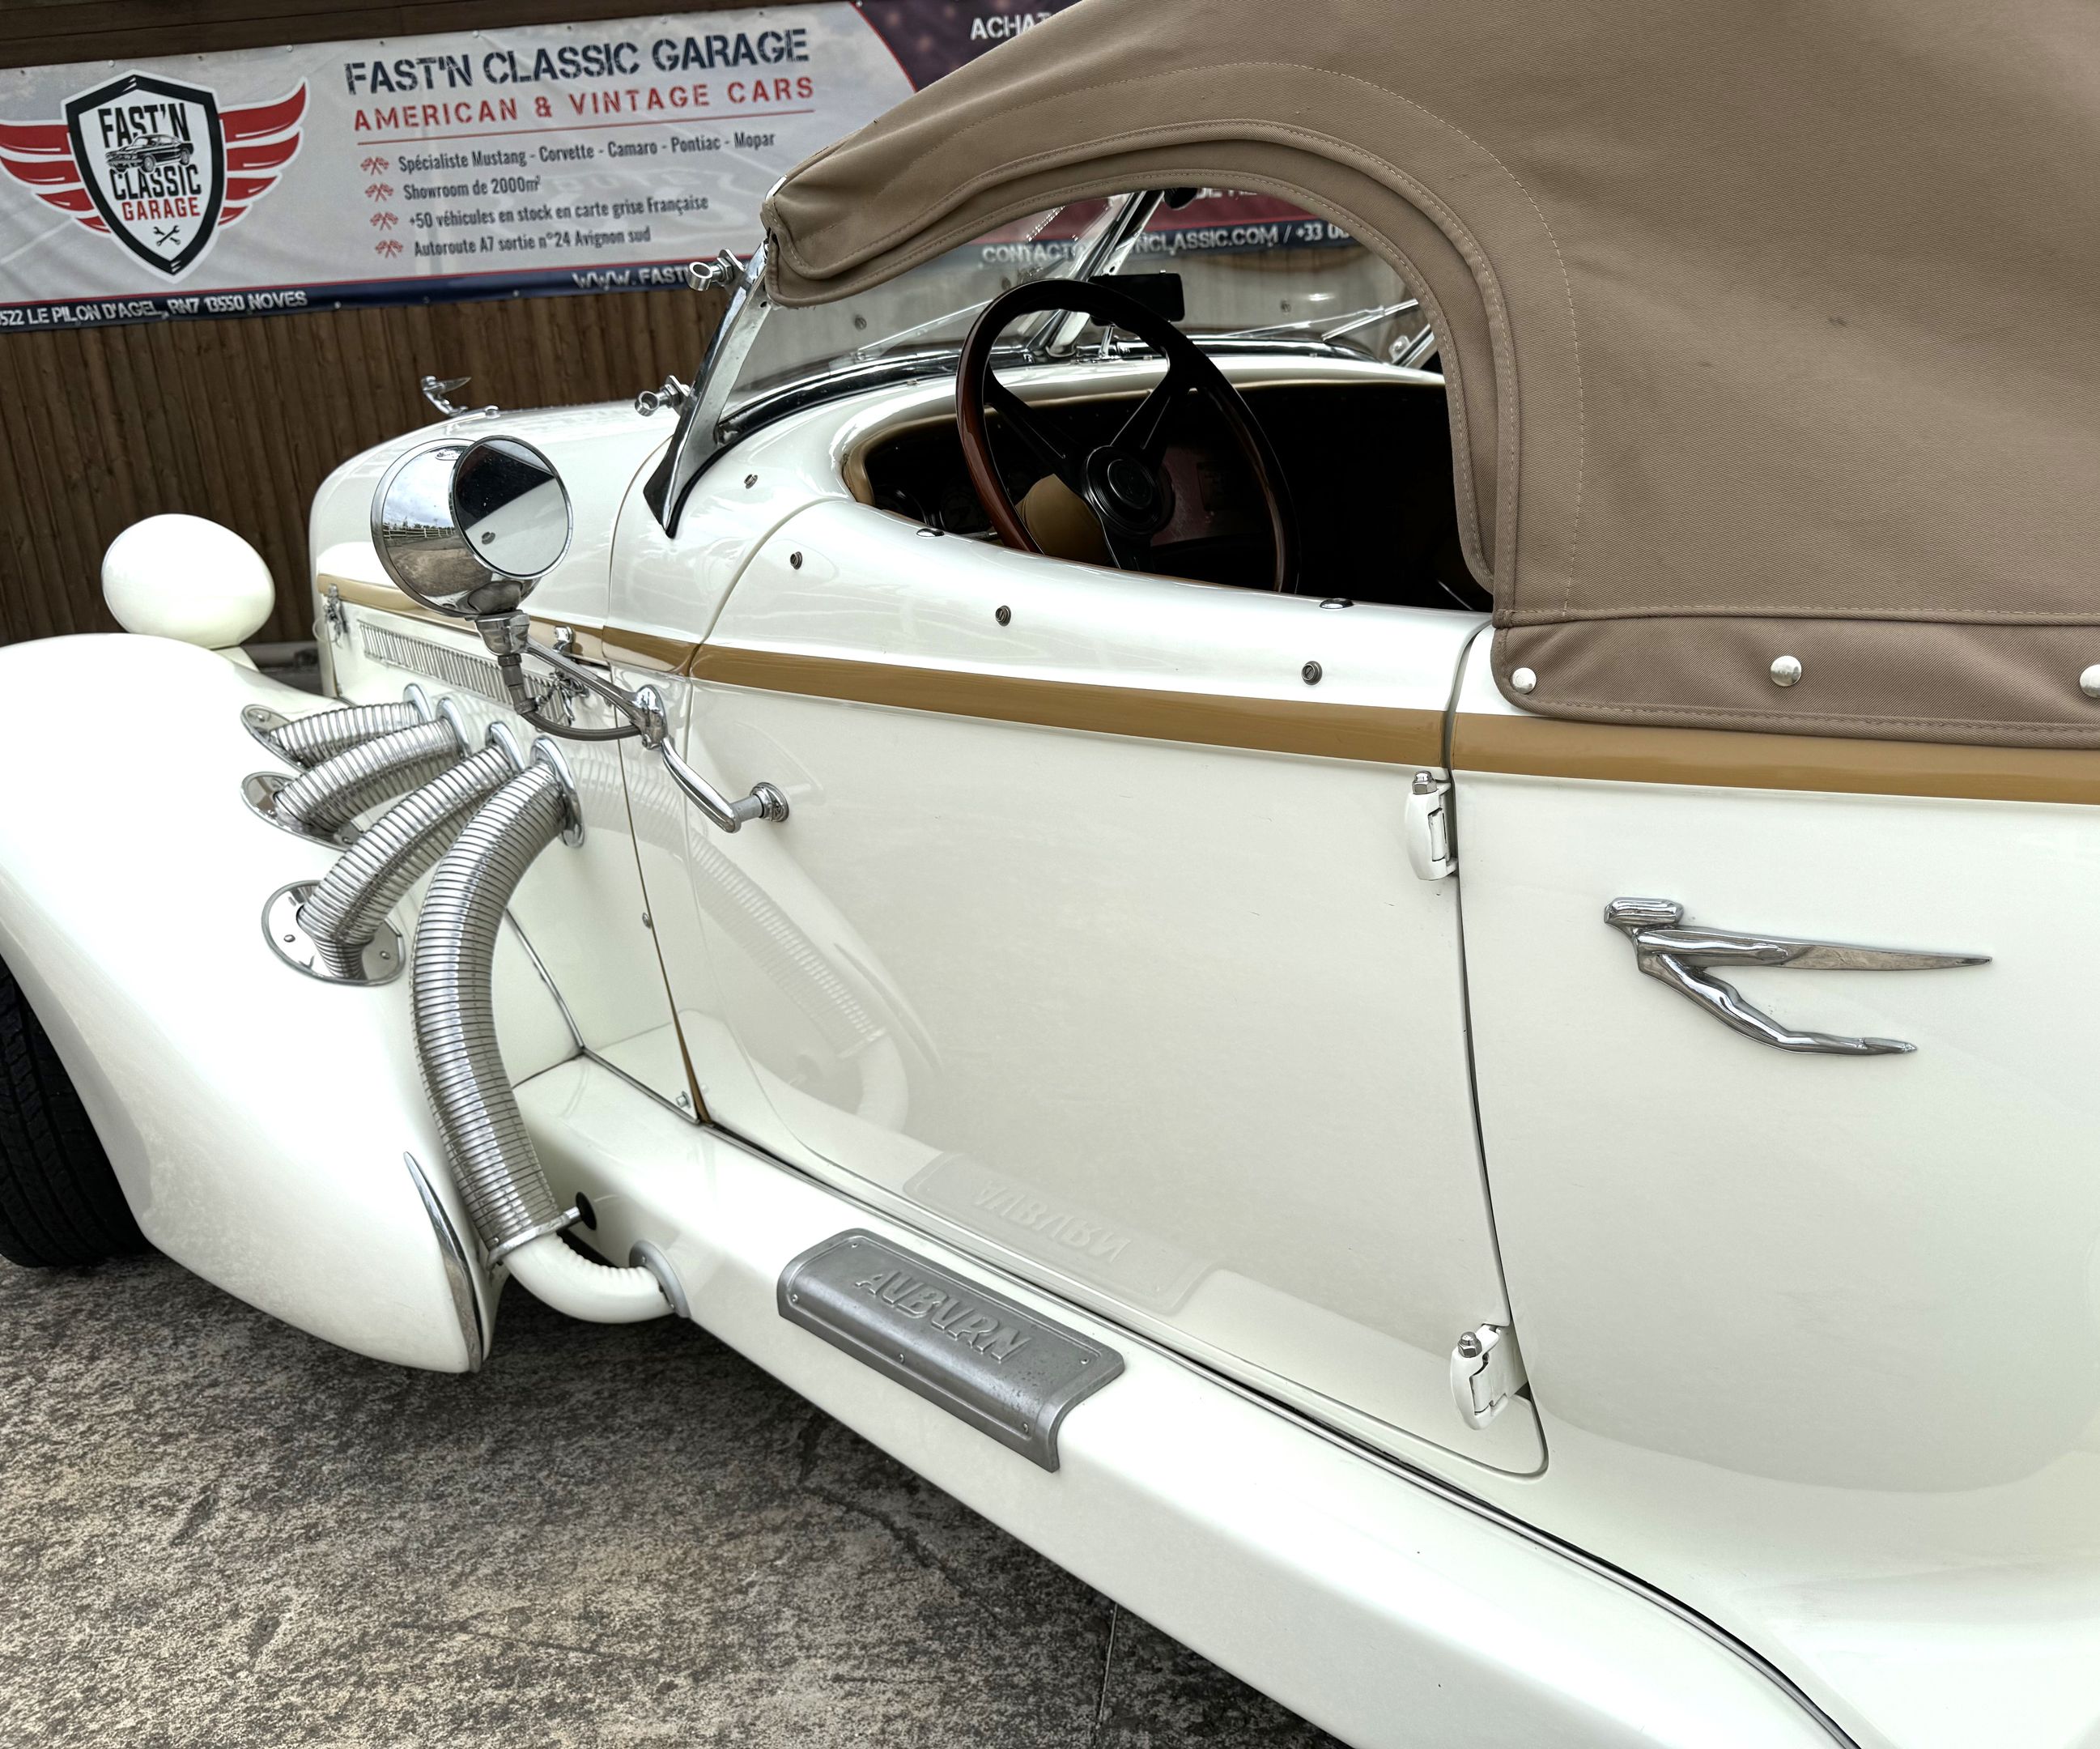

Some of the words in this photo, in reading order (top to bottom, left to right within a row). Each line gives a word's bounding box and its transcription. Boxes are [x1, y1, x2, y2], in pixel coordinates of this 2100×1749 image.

[344, 53, 474, 96] FAST'N
[483, 42, 640, 84] CLASSIC
[651, 28, 810, 72] GARAGE
[354, 96, 518, 132] AMERICAN
[534, 95, 553, 118] &
[568, 83, 710, 116] VINTAGE
[727, 76, 814, 104] CARS
[98, 103, 191, 148] FAST'N
[398, 152, 470, 175] Spécialiste
[470, 149, 528, 168] Mustang
[538, 143, 595, 163] Corvette
[608, 140, 658, 158] Camaro
[670, 134, 722, 153] Pontiac
[733, 130, 777, 149] Mopar
[109, 164, 202, 201] CLASSIC
[403, 184, 470, 201] Showroom
[472, 180, 488, 196] de
[121, 197, 201, 221] GARAGE
[409, 211, 433, 229] +50
[436, 208, 497, 228] véhicules
[498, 211, 516, 223] en
[516, 204, 553, 222] stock
[555, 206, 572, 219] en
[574, 202, 609, 219] carte
[611, 198, 644, 219] grise
[646, 194, 709, 217] Française
[414, 239, 478, 257] Autoroute
[479, 236, 495, 253] A7
[497, 234, 536, 252] sortie
[574, 228, 625, 249] Avignon
[627, 226, 651, 243] sud
[1295, 221, 1323, 242] +33
[572, 265, 690, 289] WWW.FAST
[26, 308, 50, 325] LE
[51, 304, 102, 323] PILON
[166, 297, 201, 315] RN7
[246, 291, 308, 310] NOVES
